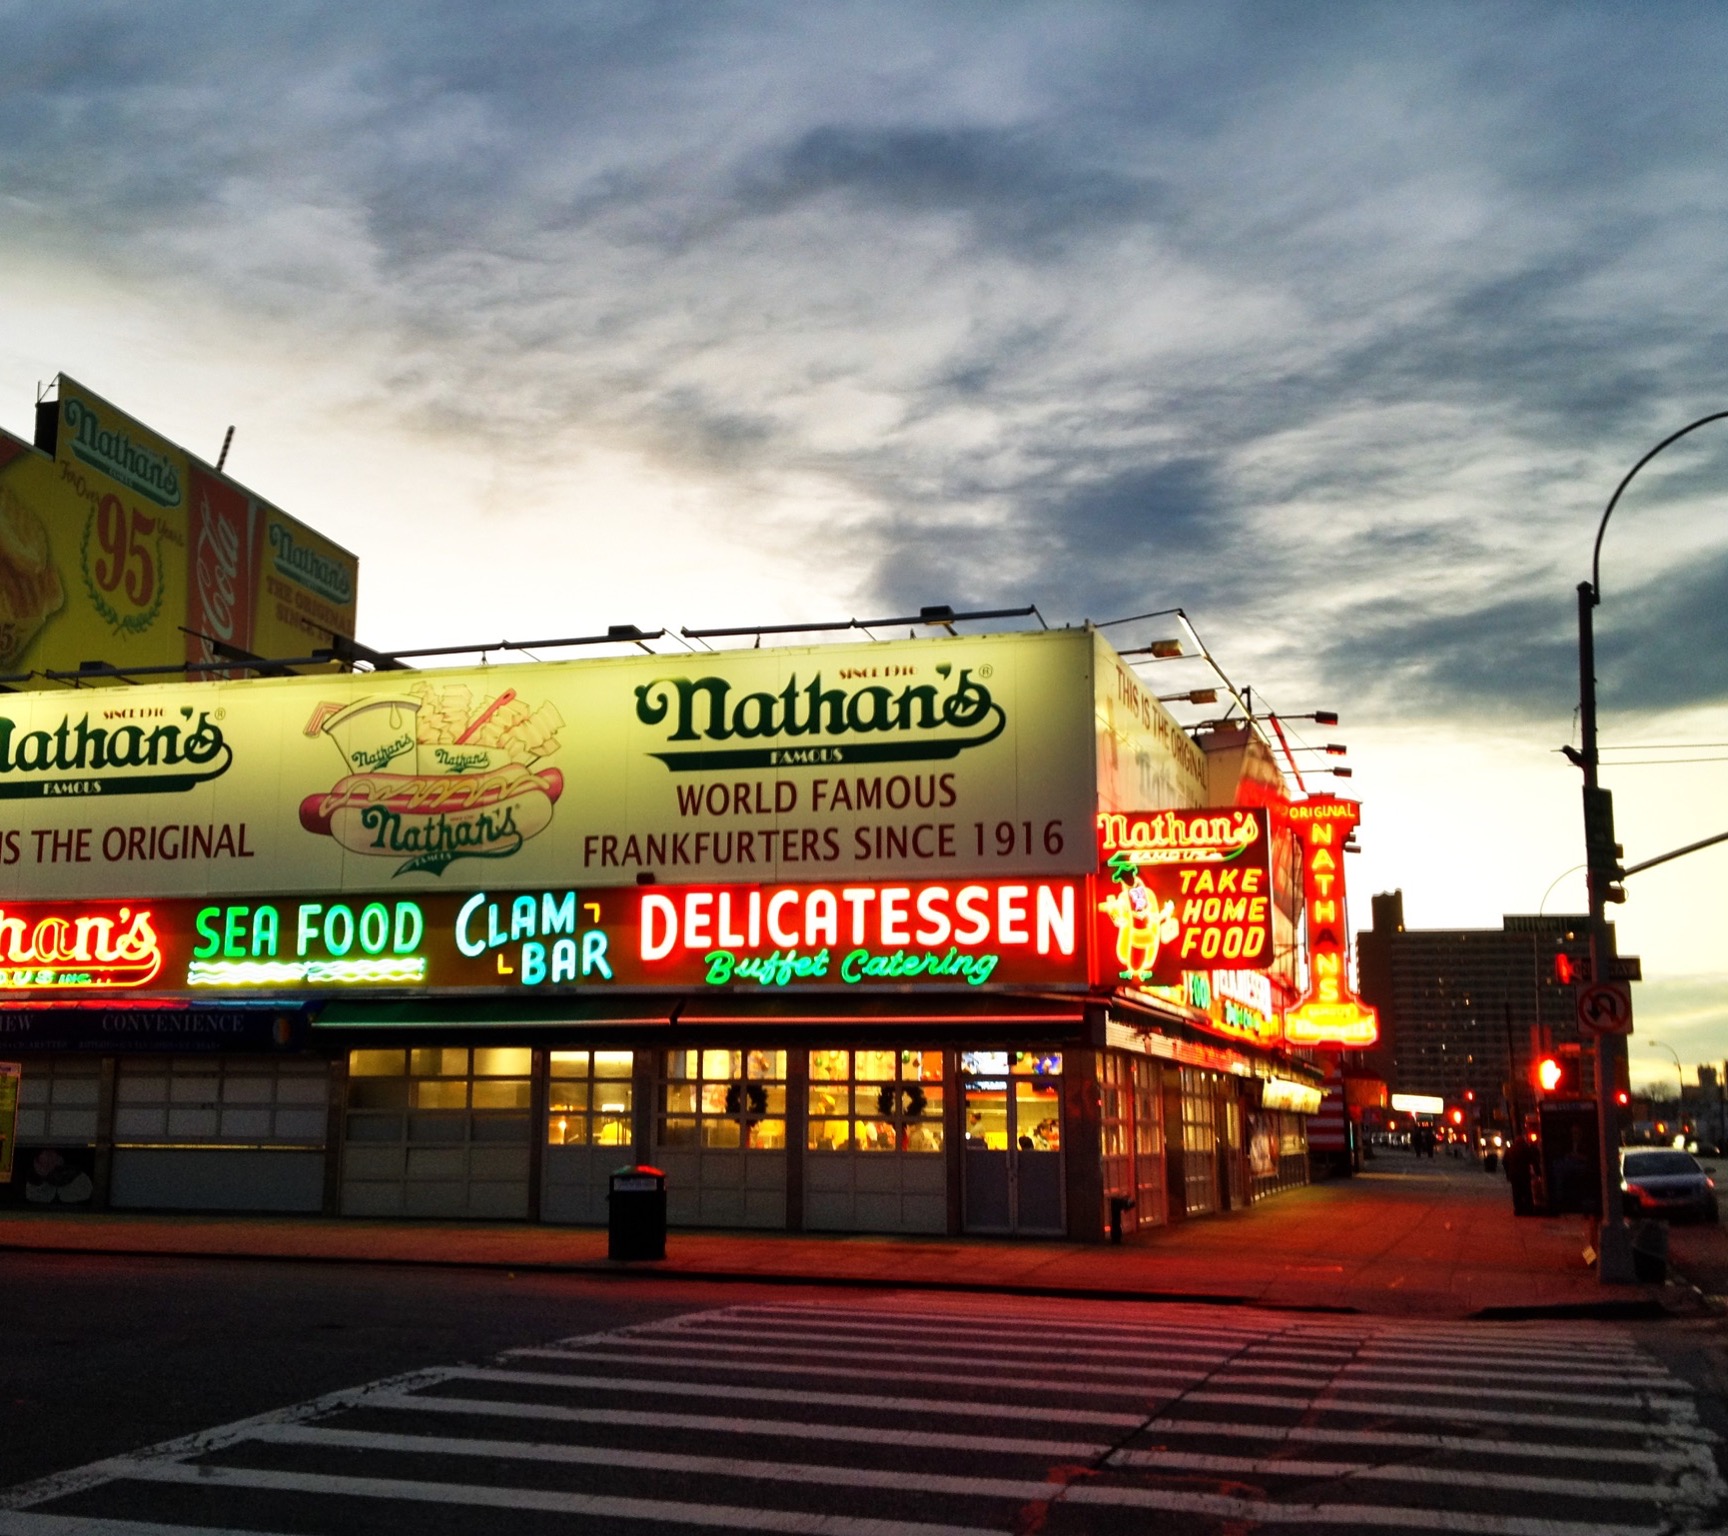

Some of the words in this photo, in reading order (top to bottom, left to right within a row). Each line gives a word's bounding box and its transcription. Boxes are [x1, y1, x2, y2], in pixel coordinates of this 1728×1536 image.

[64, 397, 181, 496] Nathan's
[95, 493, 156, 607] 95
[269, 523, 351, 594] Nathan's
[635, 661, 992, 742] Nathan's
[0, 706, 223, 773] athan's
[1115, 665, 1139, 719] THIS
[1141, 692, 1150, 731] IS
[1152, 704, 1169, 750] THE
[1171, 727, 1207, 791] ORIGINAL
[352, 733, 413, 768] Nathan's
[435, 748, 489, 768] Nathan's
[770, 747, 843, 766] FAMOUS
[43, 780, 102, 796] FAMOUS
[676, 781, 797, 817] WORLD
[811, 773, 957, 812] FAMOUS
[361, 803, 516, 852] Nathan's
[1097, 811, 1259, 849] Nathan's
[1289, 803, 1356, 818] ORIGINAL
[31, 828, 93, 863] THE
[102, 823, 255, 862] ORIGINAL
[583, 826, 840, 868] FRANKFURTERS
[853, 823, 957, 861] SINCE
[974, 820, 1064, 857] 1916
[1179, 868, 1263, 895] TAKE
[193, 904, 279, 959] SEA
[296, 901, 424, 957] FOOD
[454, 891, 578, 957] CLAM
[640, 884, 1076, 961] DELICATESSEN
[1182, 896, 1268, 924] HOME
[520, 928, 615, 985] BAR
[1181, 926, 1266, 959] FOOD
[704, 947, 831, 987] Buffet
[841, 945, 999, 985] Catering
[102, 1013, 245, 1033] CONVENIENCE
